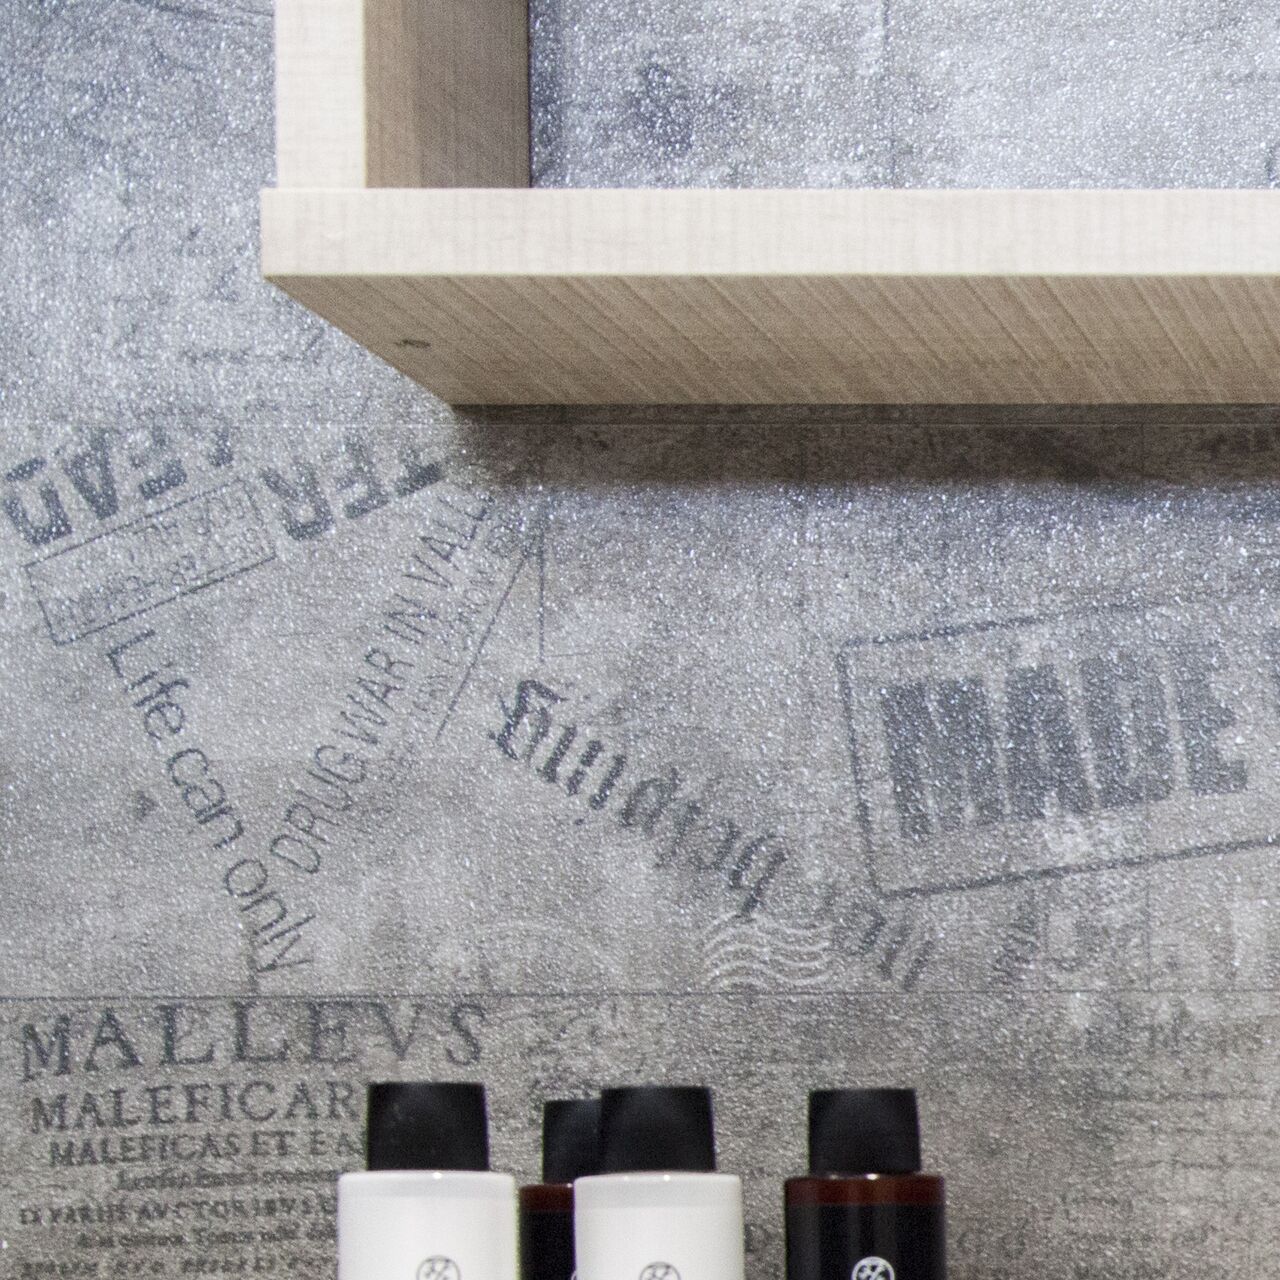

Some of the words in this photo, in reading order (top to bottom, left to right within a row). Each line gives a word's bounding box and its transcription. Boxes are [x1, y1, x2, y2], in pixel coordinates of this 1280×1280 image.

[102, 626, 191, 743] Life
[165, 744, 250, 851] can
[221, 856, 315, 979] only
[880, 638, 1248, 842] MADE
[267, 741, 372, 876] DRUG
[21, 1000, 488, 1079] MALLEVS
[30, 1079, 369, 1135] MALEFICAR
